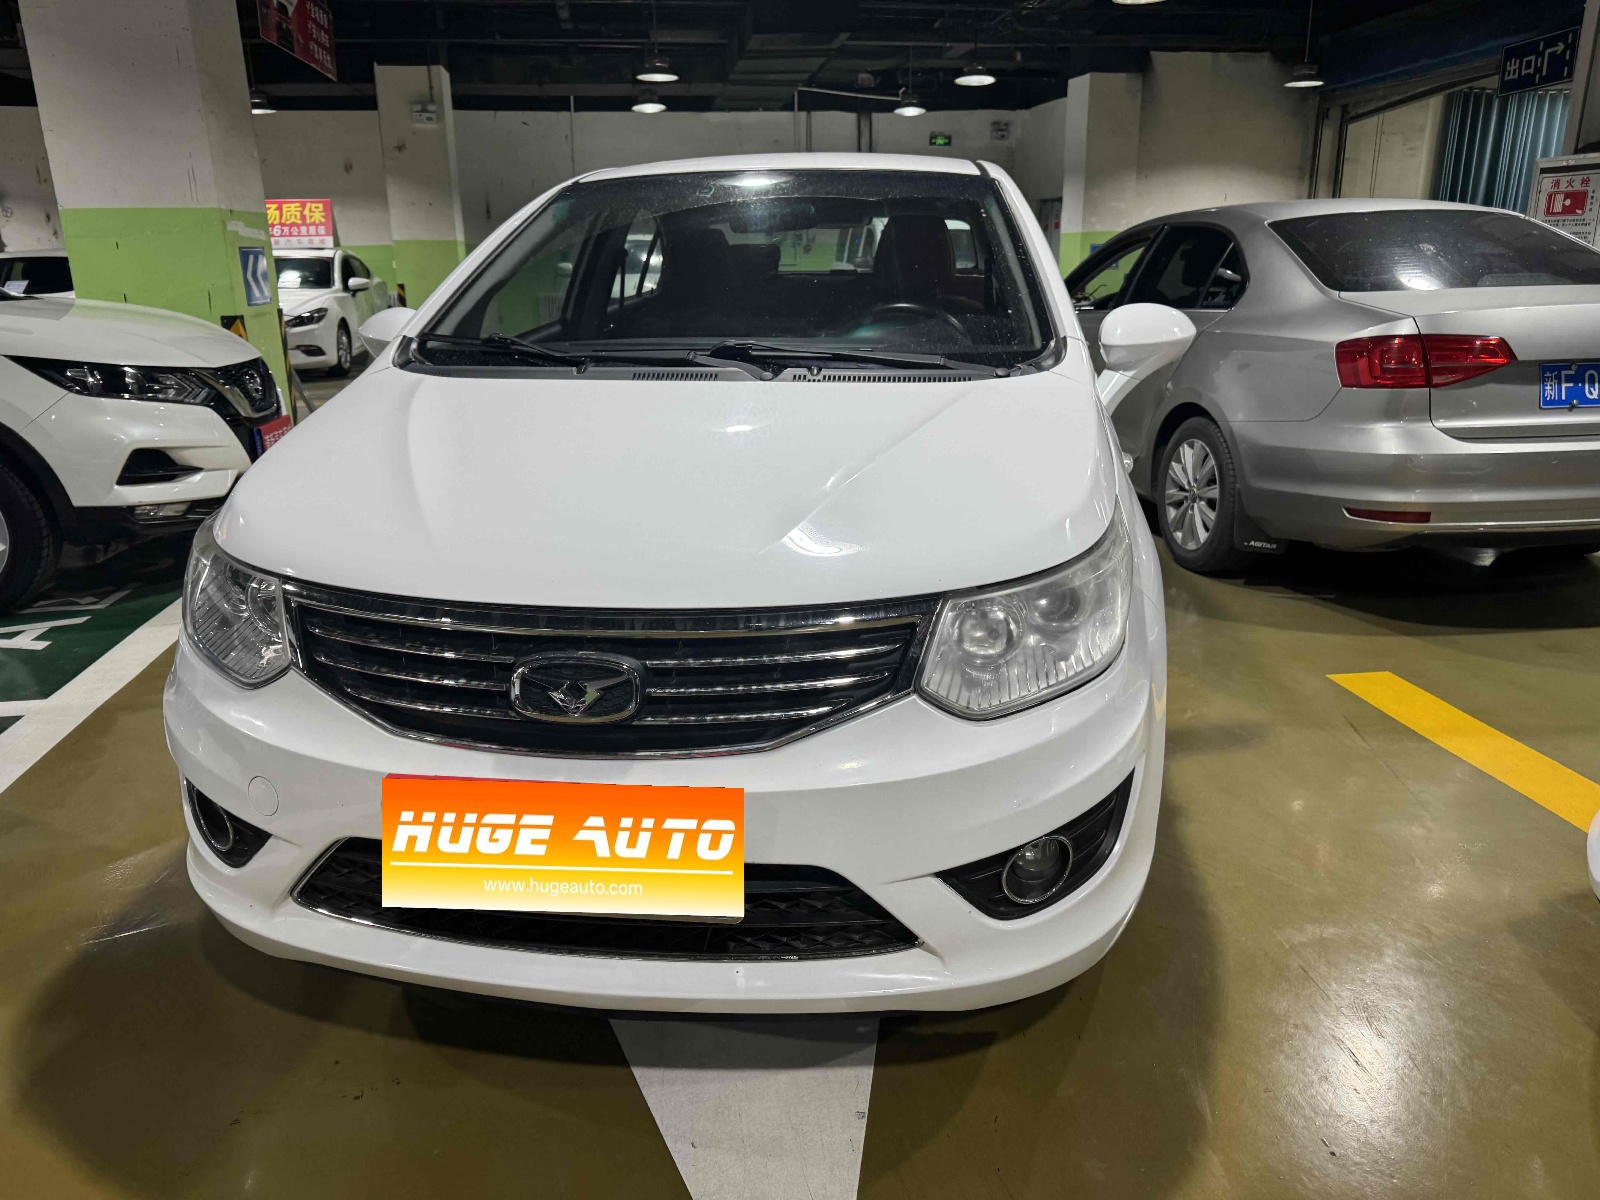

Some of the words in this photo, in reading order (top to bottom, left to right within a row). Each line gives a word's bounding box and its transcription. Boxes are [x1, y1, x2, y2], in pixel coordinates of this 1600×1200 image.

[1504, 54, 1536, 81] 出口
[1550, 176, 1592, 190] 消火栓
